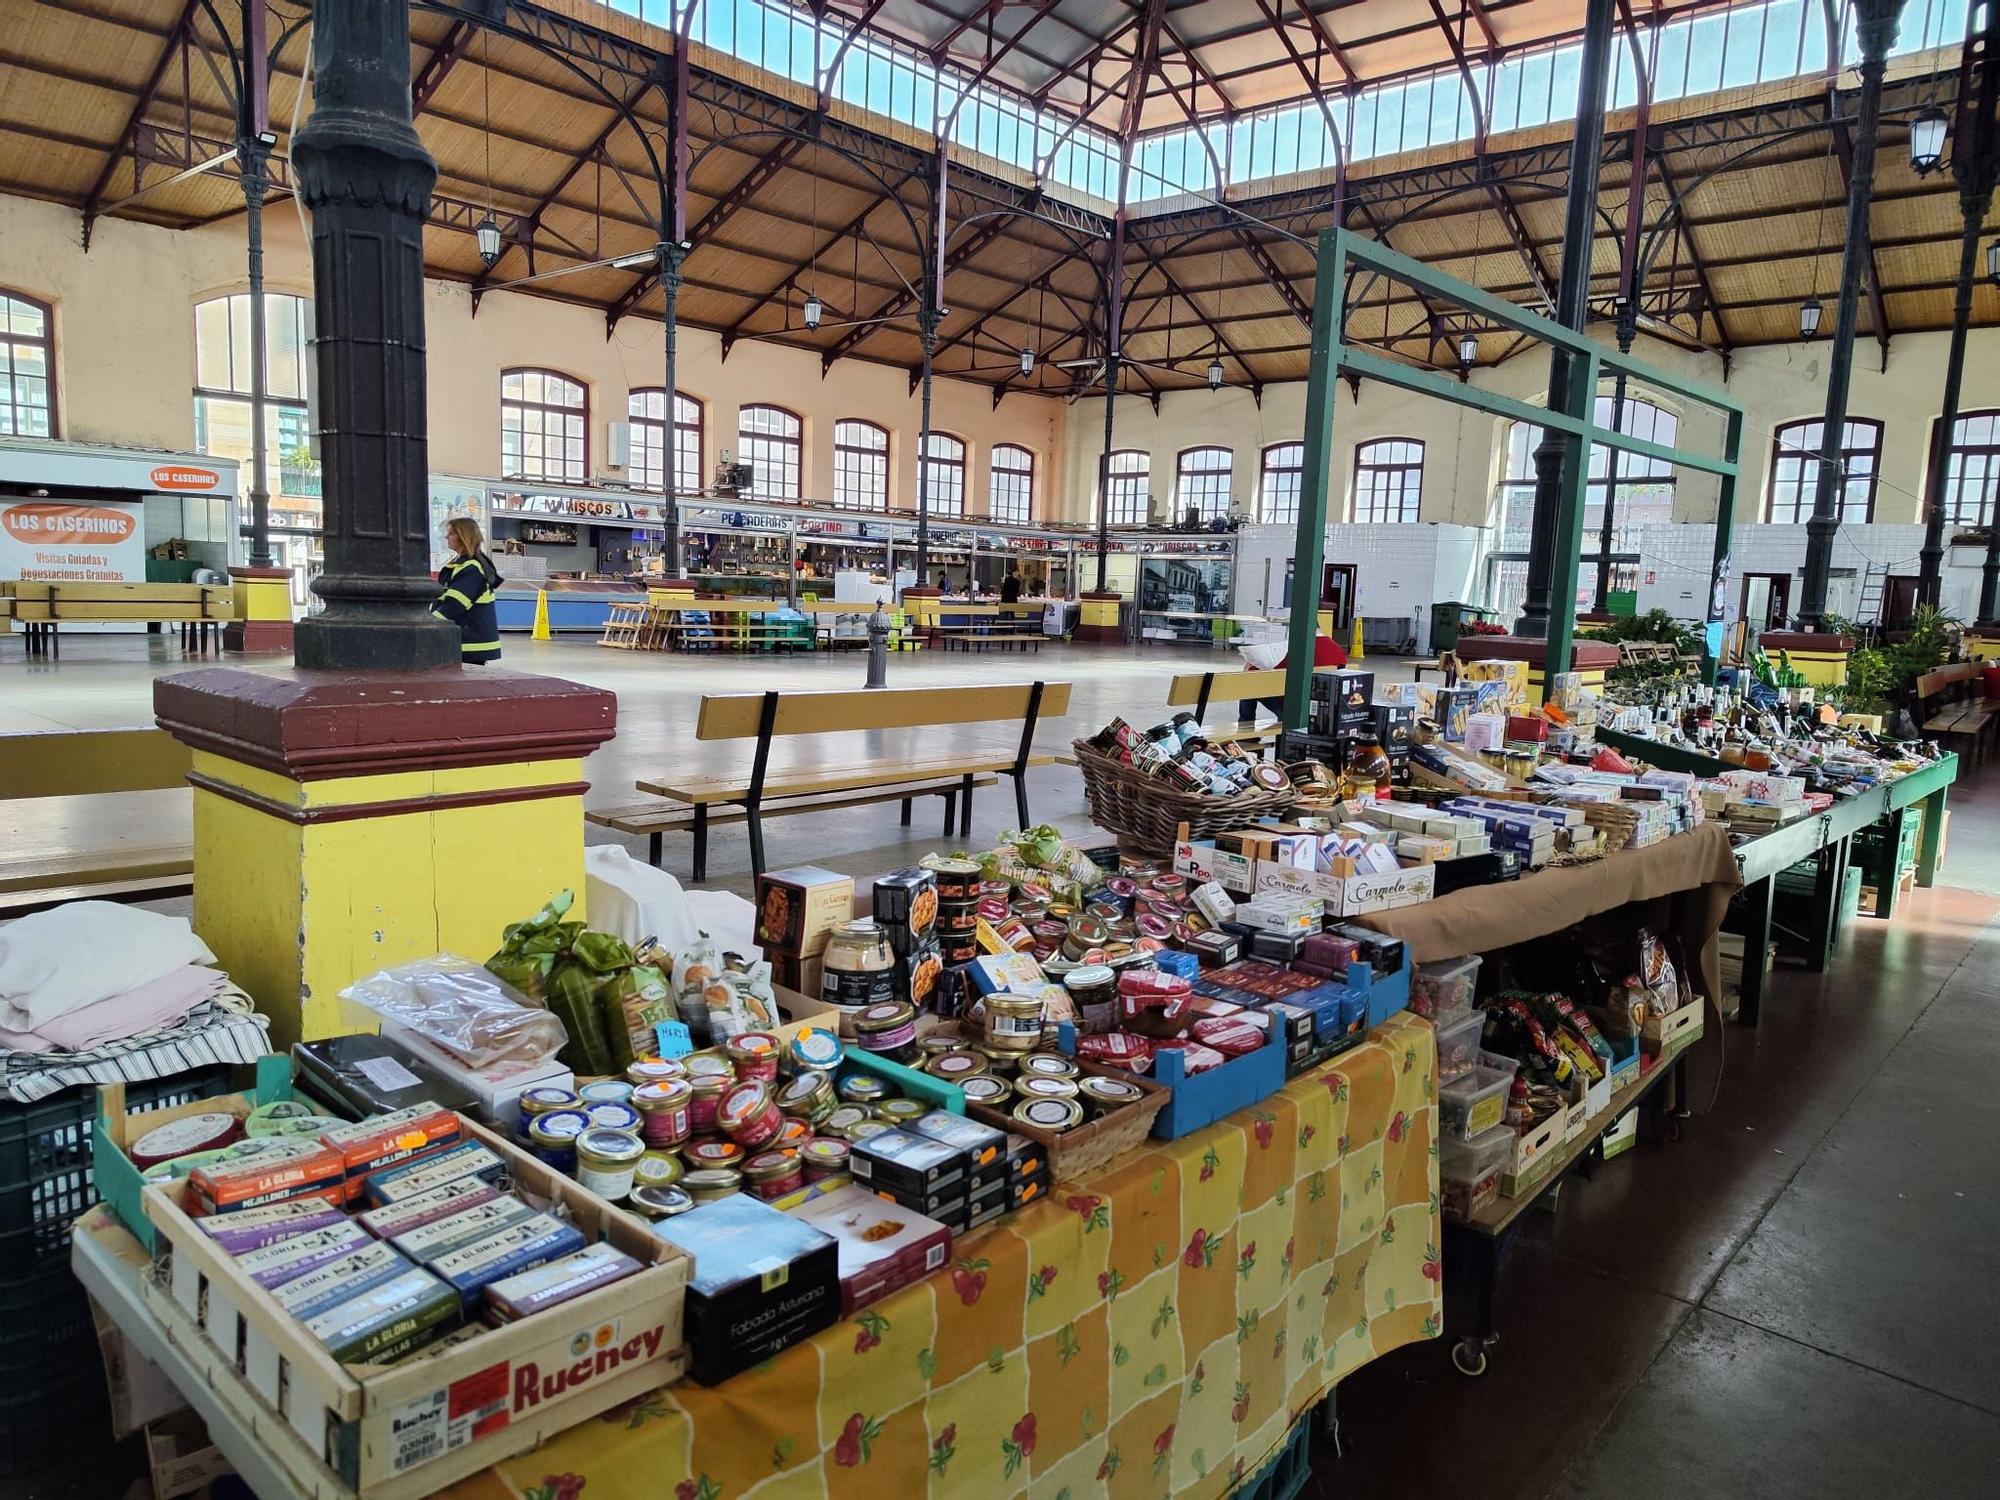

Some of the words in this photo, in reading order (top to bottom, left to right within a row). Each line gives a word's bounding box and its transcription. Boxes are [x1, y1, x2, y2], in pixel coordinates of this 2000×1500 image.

[154, 472, 170, 481] LOS
[172, 474, 216, 484] CASERINOS
[9, 513, 39, 530] LOS
[45, 515, 128, 534] CASERINOS
[36, 552, 67, 565] Visitas
[67, 553, 102, 566] Guiadas
[102, 556, 108, 566] y
[20, 568, 84, 580] Degustaciones
[85, 569, 124, 581] Gratuitas
[1350, 877, 1406, 903] Carmelo
[382, 1140, 396, 1152] LA
[259, 1179, 273, 1190] LA
[272, 1169, 306, 1182] GLORIA
[242, 1188, 291, 1209] MEJILLONES
[372, 1210, 387, 1220] LA
[389, 1198, 428, 1214] GLORIA
[210, 1218, 225, 1226] LA
[227, 1210, 272, 1223] GLORIA
[425, 1218, 466, 1236] GLORIA
[255, 1245, 300, 1261] GLORIA
[444, 1257, 460, 1268] LA
[461, 1240, 504, 1260] GLORIA
[286, 1273, 331, 1296] GLORIA
[731, 1308, 777, 1338] Fabada
[779, 1285, 825, 1312] Asturiana
[365, 1337, 381, 1351] LA
[381, 1318, 418, 1343] GLORIA
